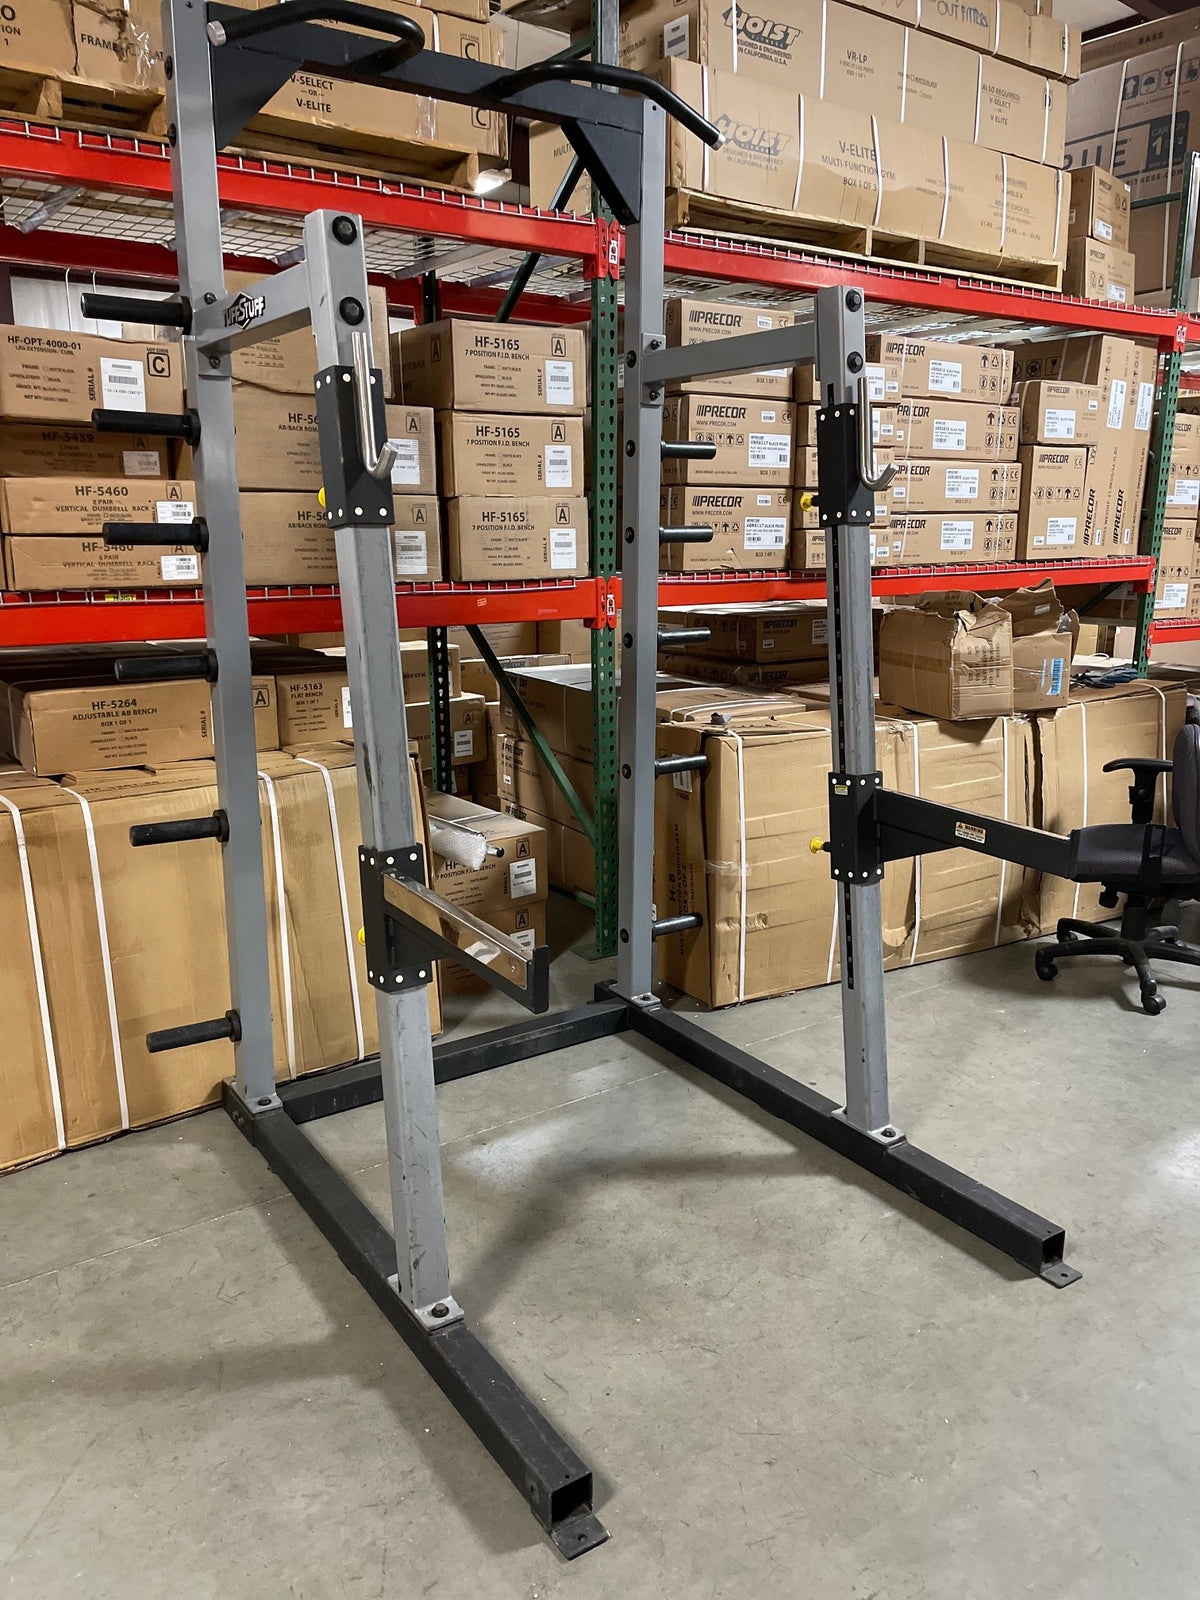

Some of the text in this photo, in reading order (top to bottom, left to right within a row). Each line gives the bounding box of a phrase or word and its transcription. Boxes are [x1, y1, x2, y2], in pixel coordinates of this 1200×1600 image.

[725, 10, 801, 46] HOIST
[736, 38, 760, 51] ESIGNED
[463, 44, 478, 60] C
[846, 50, 868, 64] VR-LP
[289, 74, 334, 91] V-SELECT
[982, 83, 995, 94] ALSO
[295, 97, 332, 114] V-ELITE
[475, 109, 488, 128] C
[716, 118, 792, 152] HOIST
[838, 141, 877, 161] V-ELITE
[1152, 136, 1163, 156] 1
[842, 176, 857, 187] BOX
[690, 310, 743, 329] PRECOR
[7, 335, 81, 351] HF-OPT-4000-01
[475, 336, 519, 351] HF-5165
[554, 339, 564, 355] A
[885, 342, 926, 357] PRECOR
[470, 351, 496, 360] POSITION
[511, 353, 529, 361] BENCH
[152, 355, 165, 374] C
[88, 372, 96, 401] SERIAL
[698, 405, 747, 420] PRECOR
[408, 417, 418, 431] A
[476, 425, 520, 439] HF-5165
[554, 425, 564, 441] A
[1043, 453, 1069, 464] PRECOR
[75, 485, 129, 497] HF-5460
[169, 487, 179, 499] A
[693, 495, 742, 508] PRECOR
[415, 508, 425, 522] A
[482, 512, 525, 523] HF-5165
[558, 508, 568, 523] A
[1083, 489, 1095, 543] PRECOR
[1112, 489, 1124, 543] PRECOR
[890, 518, 926, 530] PRECOR
[62, 562, 94, 570] VERTICAL
[763, 619, 798, 630] PRECOR
[289, 682, 324, 693] HF-5163
[257, 691, 269, 706] A
[290, 691, 323, 700] FLAT BENCH
[91, 698, 138, 711] HF-5264
[72, 707, 157, 722] ADJUSTABLE AB BENCH
[464, 712, 473, 724] A
[101, 720, 113, 728] BOX
[518, 843, 528, 857] A
[440, 870, 465, 881] POSITION
[668, 873, 676, 903] H-8
[518, 913, 528, 927] A
